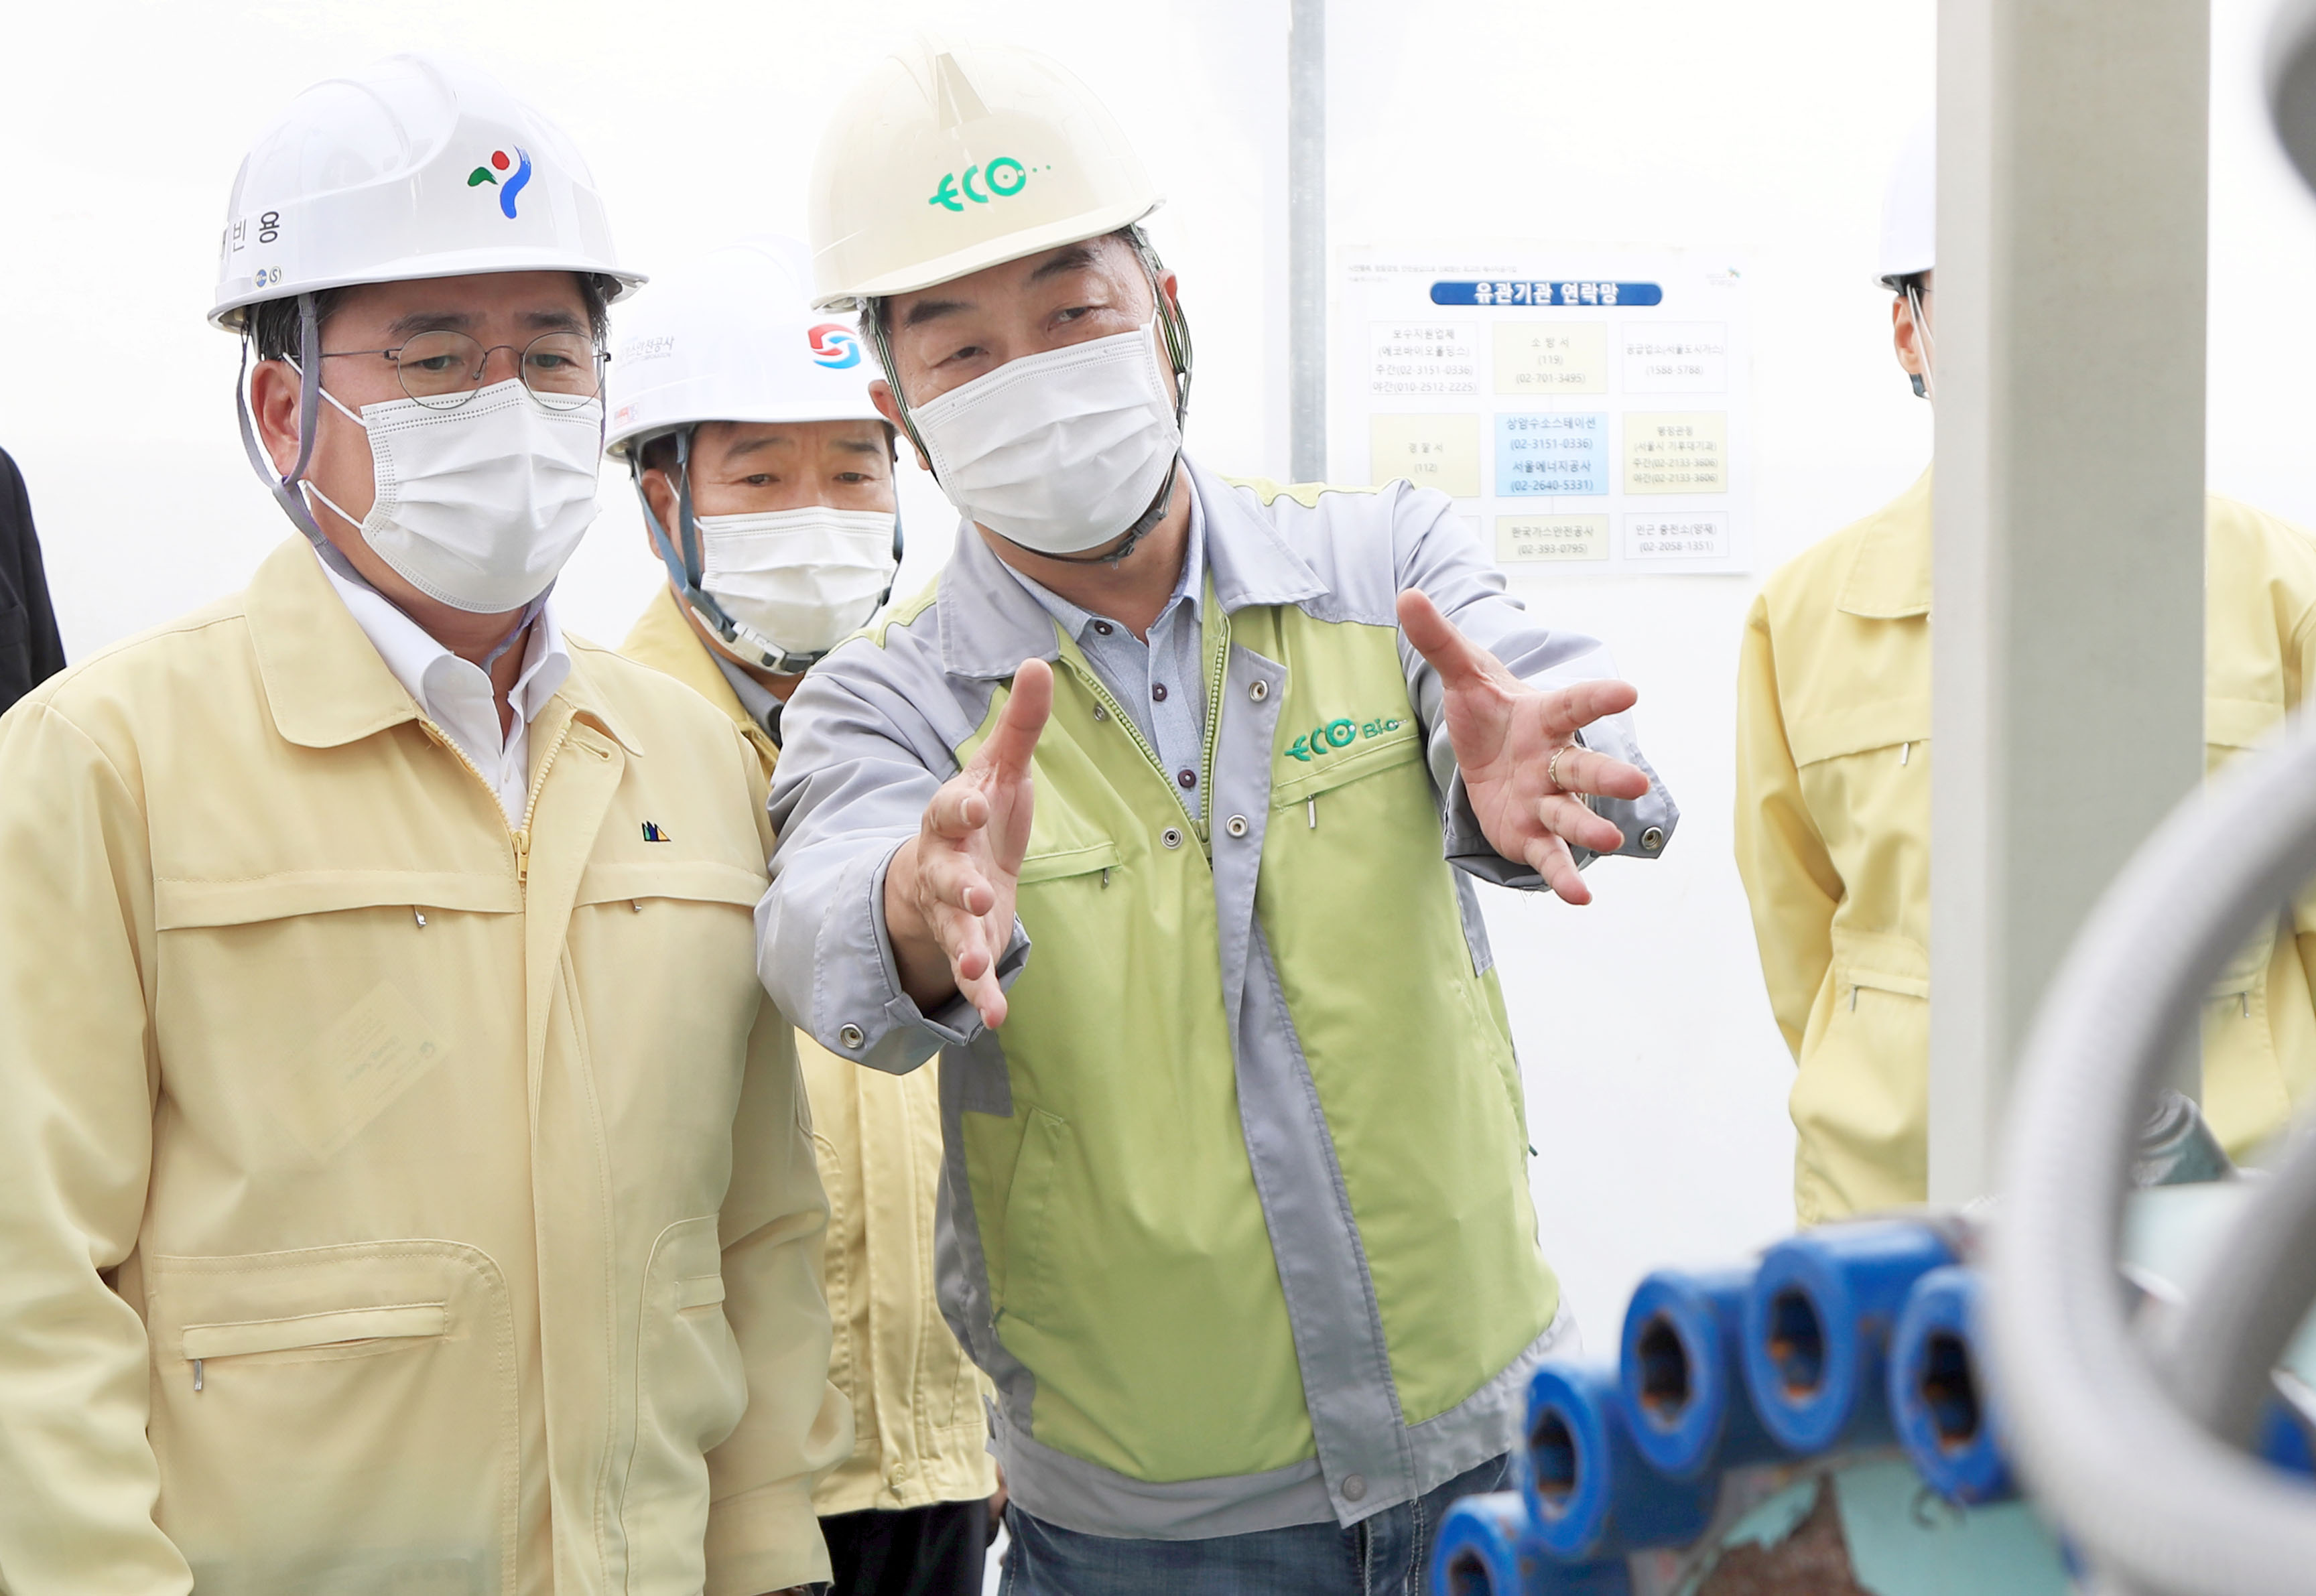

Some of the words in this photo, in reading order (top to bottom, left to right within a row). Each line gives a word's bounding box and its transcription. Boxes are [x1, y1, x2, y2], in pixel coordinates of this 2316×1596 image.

[929, 157, 1026, 212] ECO
[1474, 283, 1553, 304] 유관기관
[1561, 282, 1620, 304] 연락망
[1539, 355, 1563, 366] (119)
[1506, 417, 1596, 430] 상암수소스테이션
[1510, 438, 1593, 451] (02-3151-0336)
[1415, 464, 1437, 474] (112)
[1513, 460, 1591, 473] 서울에너지공사
[1510, 480, 1594, 492] (02-2640-5331)
[1512, 525, 1594, 538] 한국가스안전공사
[1636, 525, 1655, 535] 인근
[1284, 718, 1356, 761] ECO
